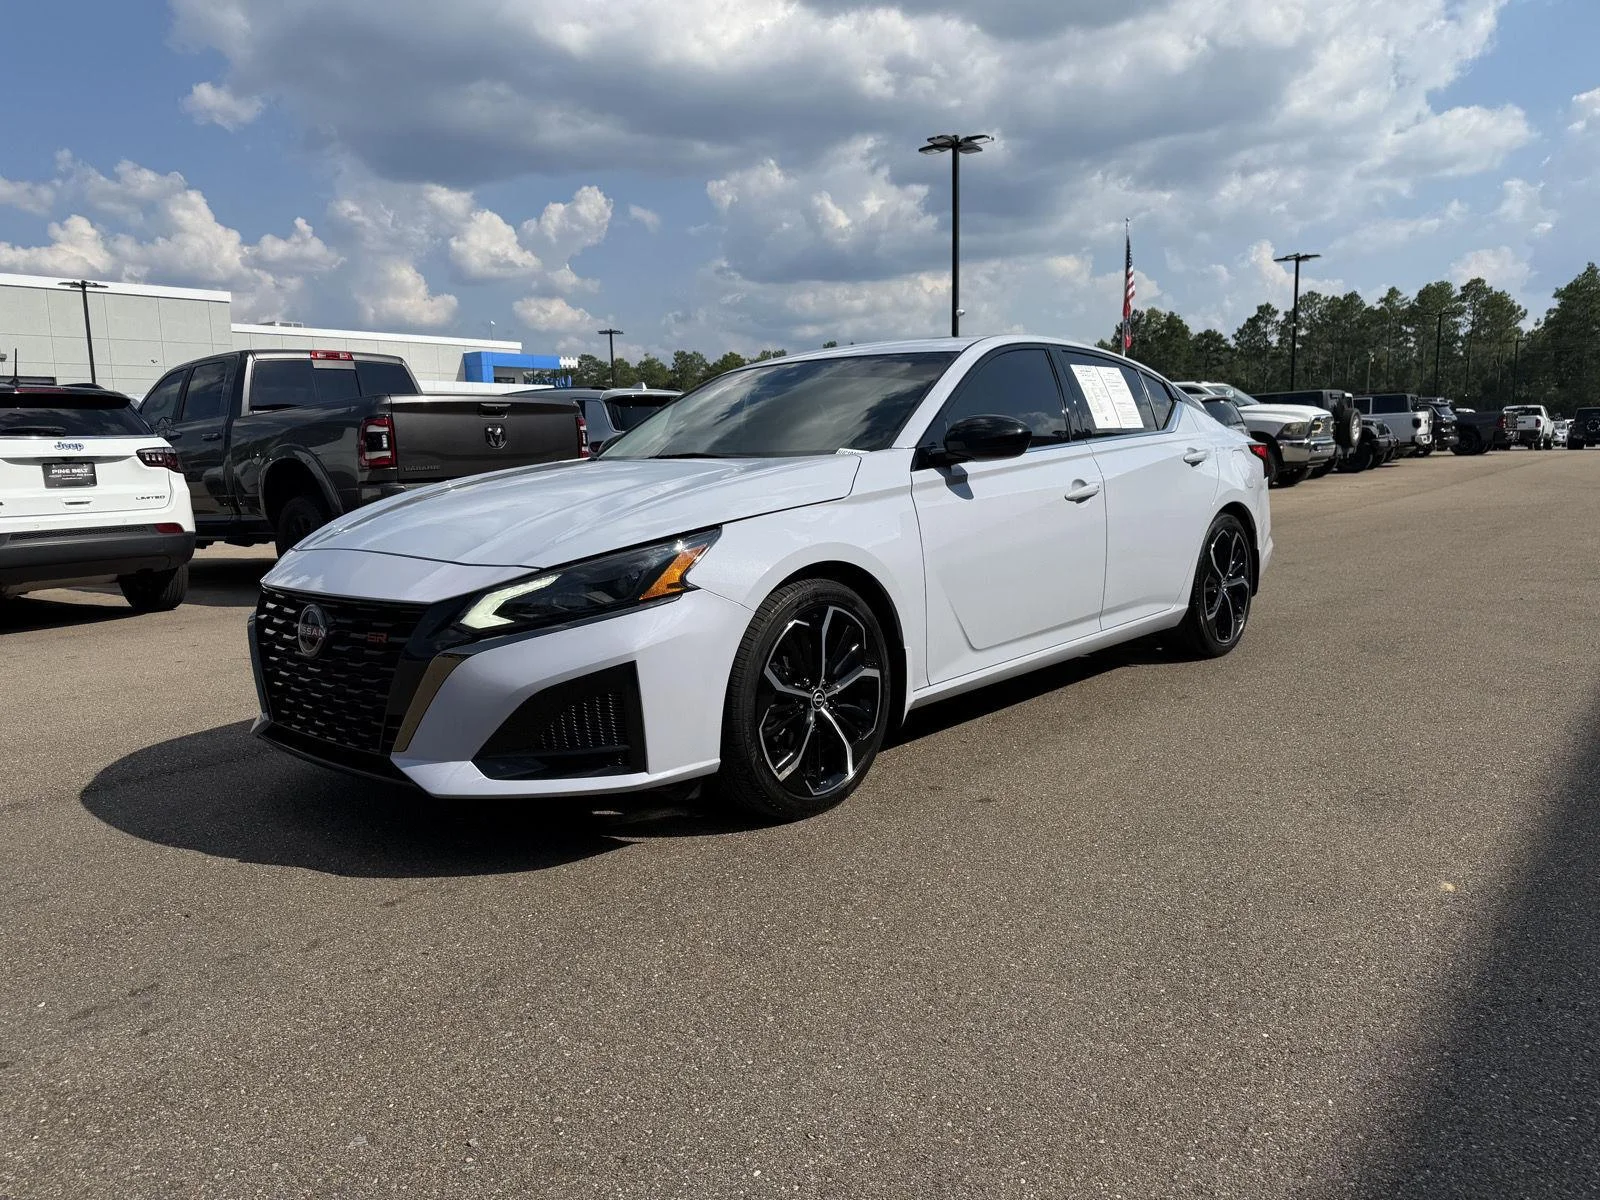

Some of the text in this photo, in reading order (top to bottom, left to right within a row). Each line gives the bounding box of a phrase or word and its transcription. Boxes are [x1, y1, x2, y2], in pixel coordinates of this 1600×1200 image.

[54, 441, 84, 451] Jeep
[299, 624, 326, 638] SSAN
[367, 632, 388, 643] SR
